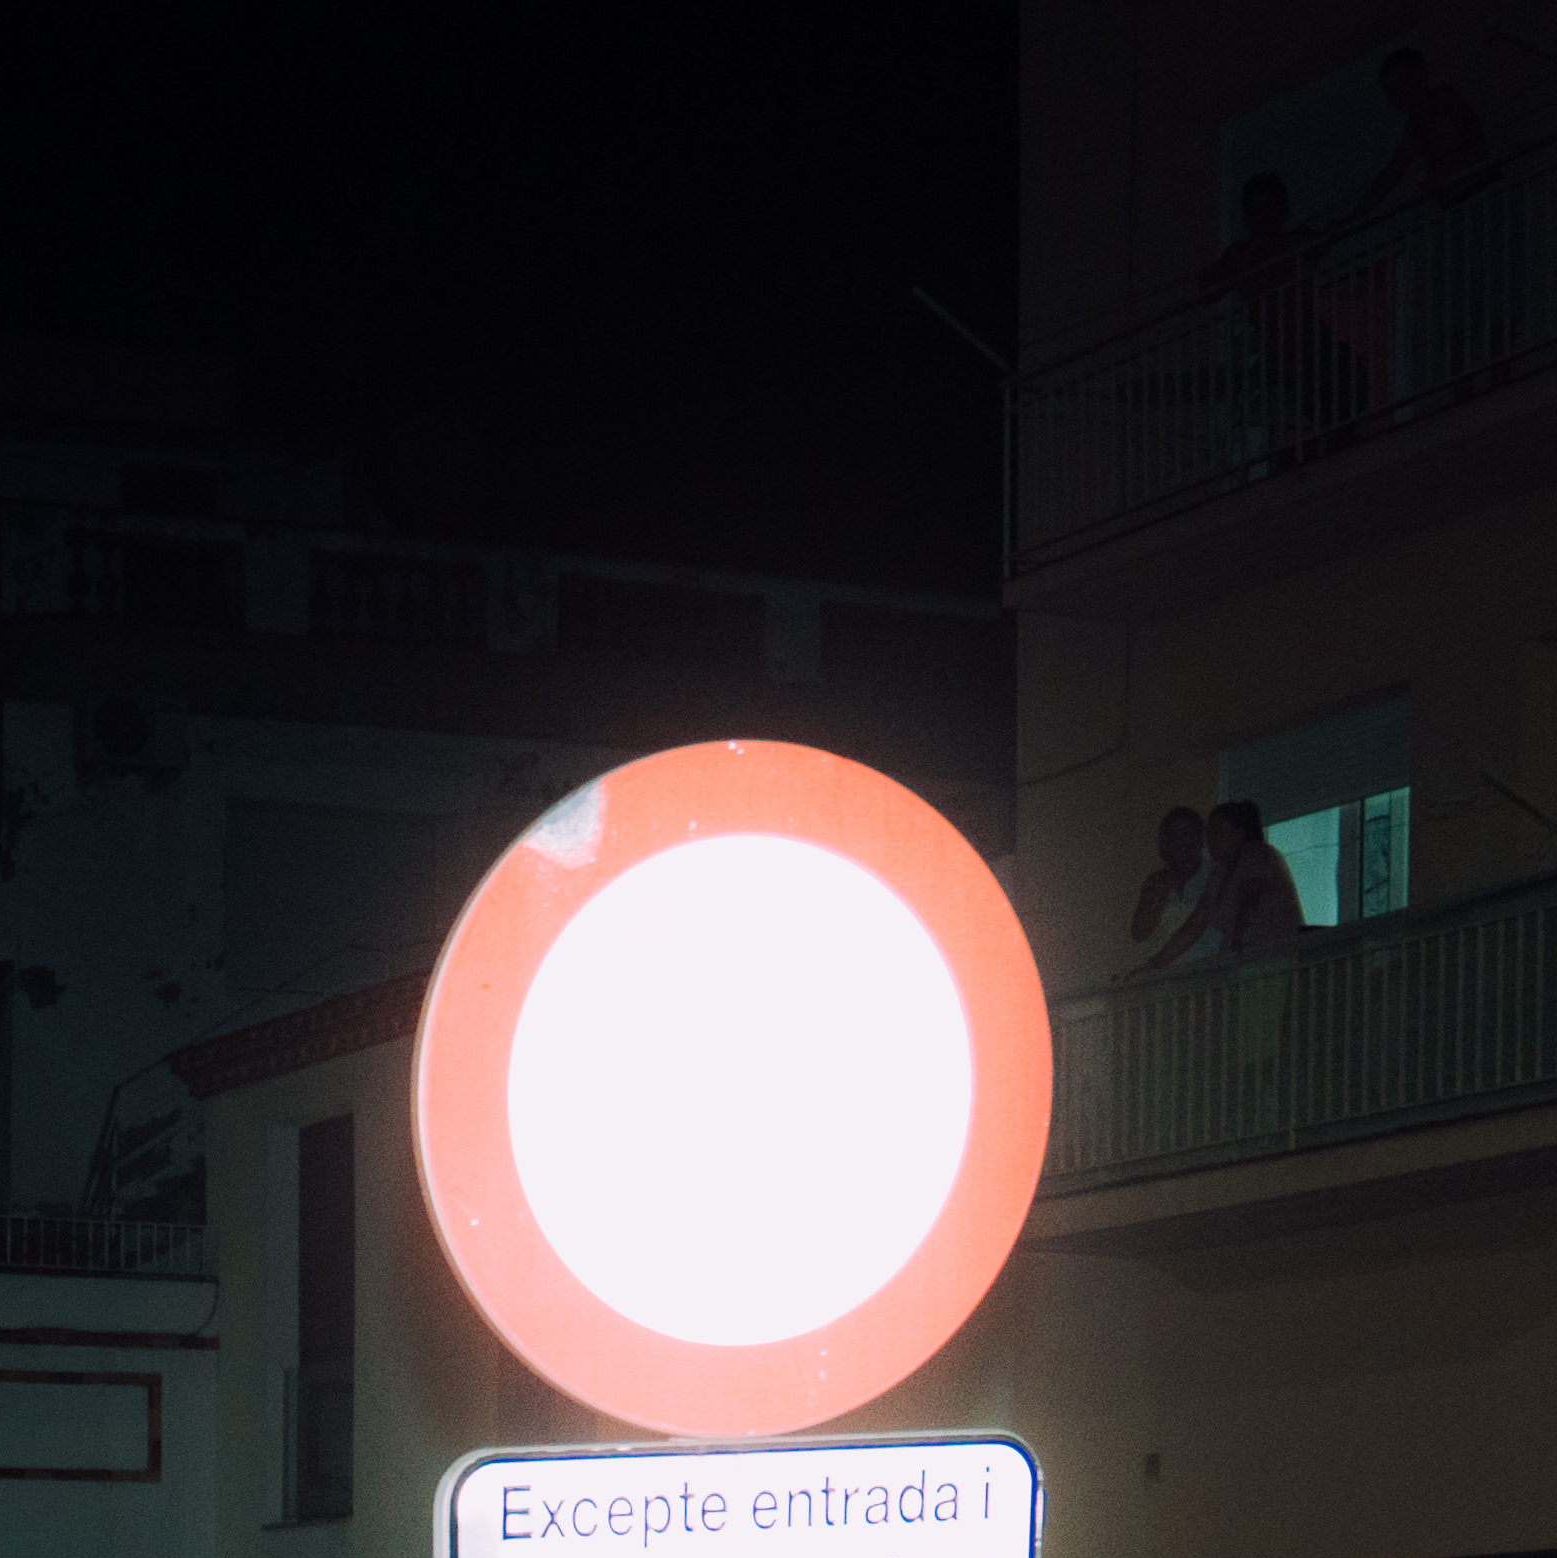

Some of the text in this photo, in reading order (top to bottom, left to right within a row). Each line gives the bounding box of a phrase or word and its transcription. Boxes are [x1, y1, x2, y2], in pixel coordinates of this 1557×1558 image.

[501, 1466, 991, 1548] Excepte entrada i
